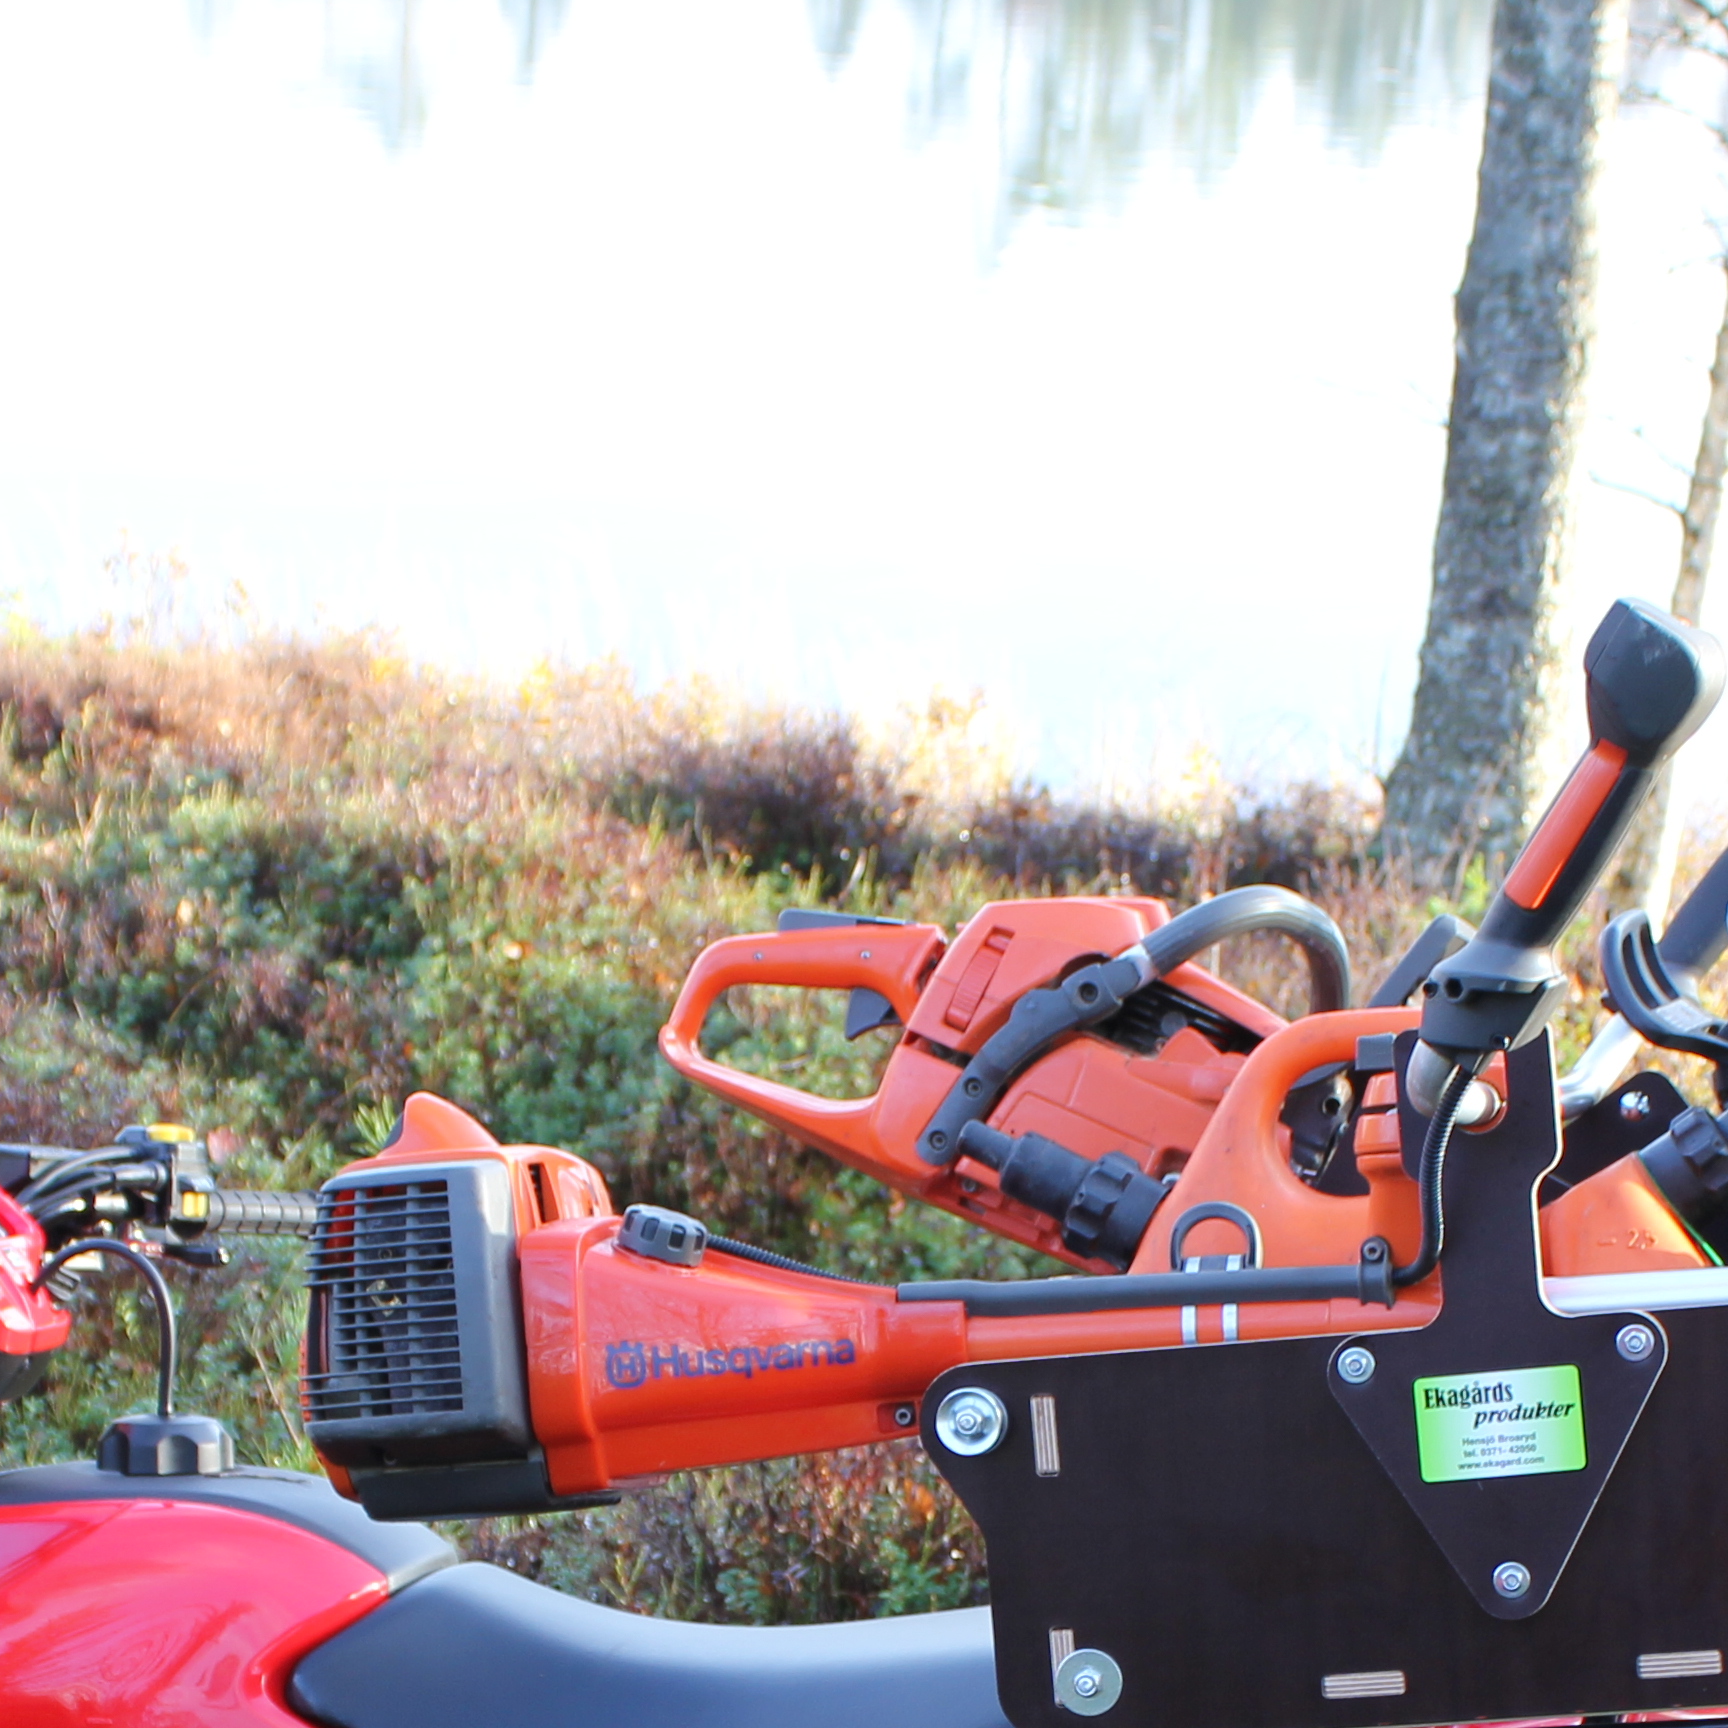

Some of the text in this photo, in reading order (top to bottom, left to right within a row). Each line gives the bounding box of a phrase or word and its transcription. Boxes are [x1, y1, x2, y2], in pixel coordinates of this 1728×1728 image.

[650, 1337, 857, 1379] Husqvarna
[1423, 1381, 1514, 1410] Ekagårds
[1473, 1402, 1575, 1429] produkter
